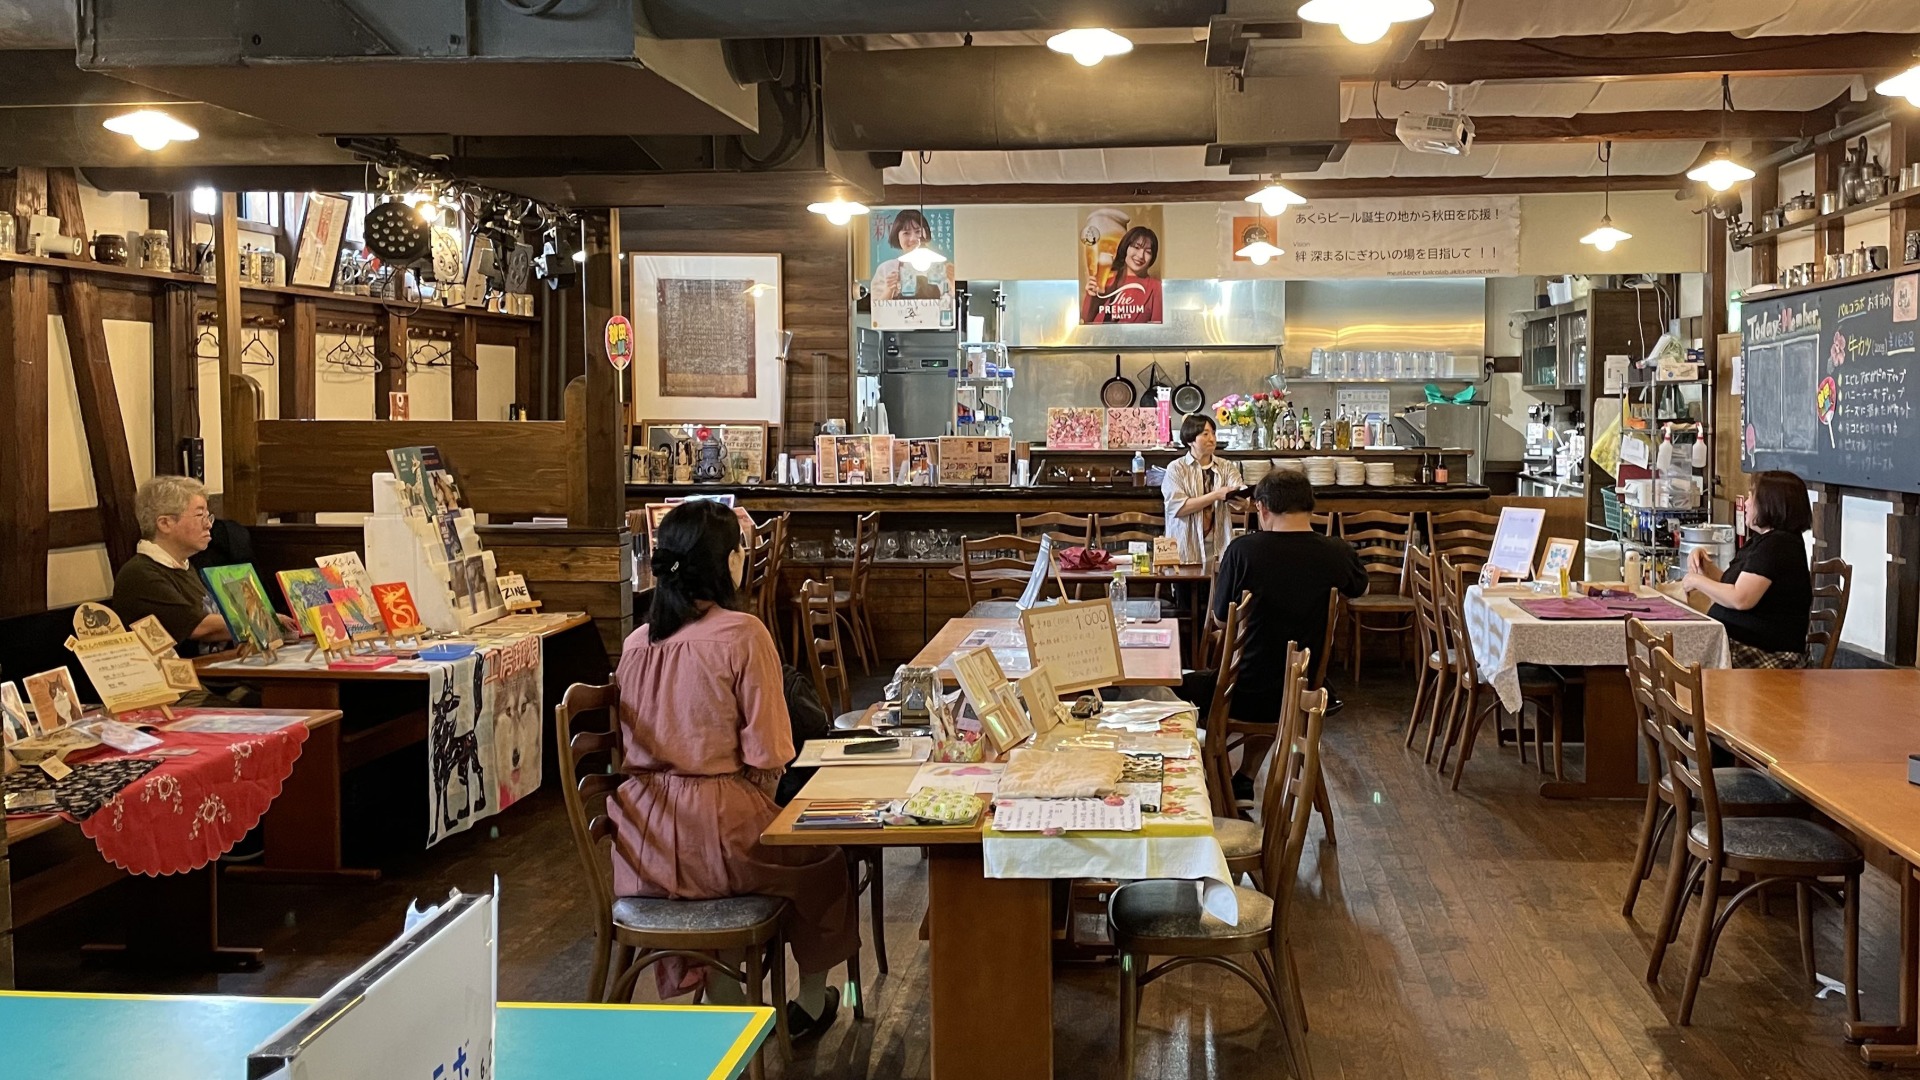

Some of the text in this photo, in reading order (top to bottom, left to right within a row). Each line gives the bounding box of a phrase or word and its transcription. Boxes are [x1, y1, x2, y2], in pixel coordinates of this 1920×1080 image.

[1295, 208, 1499, 224] あくらビール誕生の地から秋田を応援！
[1295, 250, 1307, 263] 絆
[1310, 247, 1472, 262] 深まるにぎわいの場を目指して
[872, 298, 940, 308] SUNTORY GIN
[1098, 304, 1145, 314] PREMIUM
[1746, 311, 1782, 342] Today's
[501, 585, 527, 600] ZINE
